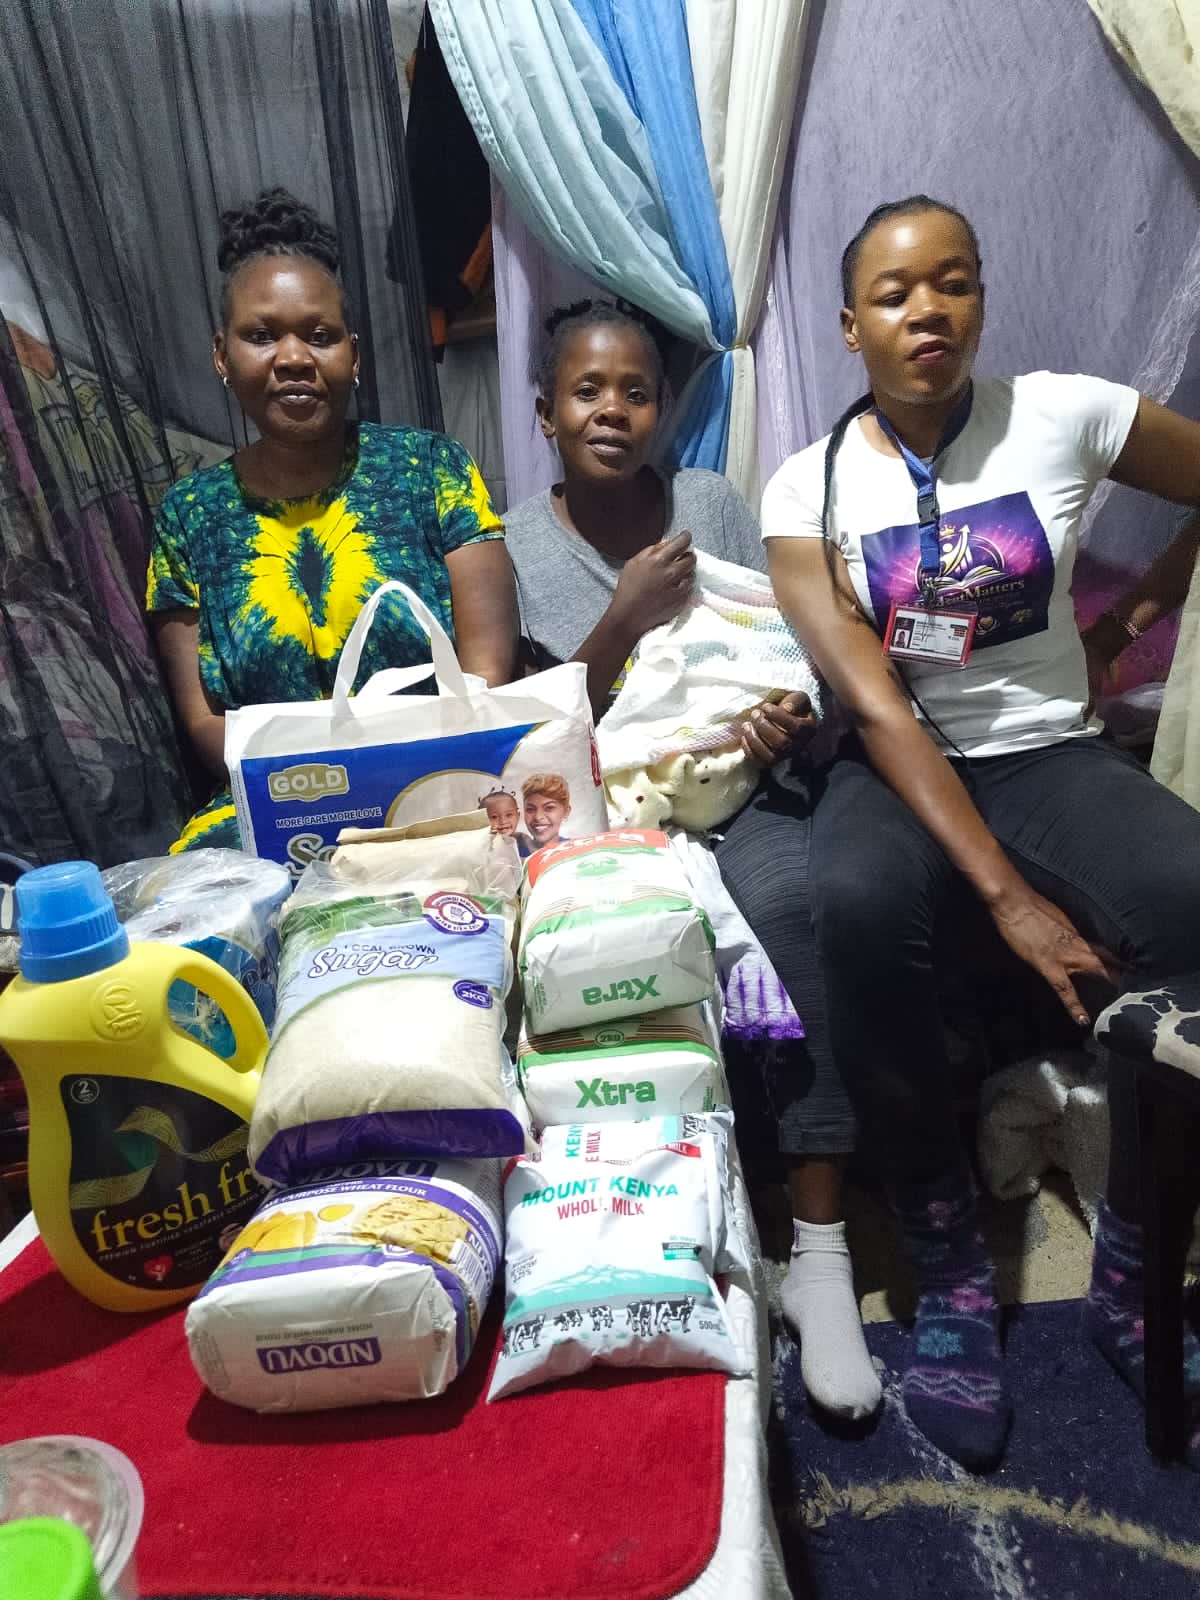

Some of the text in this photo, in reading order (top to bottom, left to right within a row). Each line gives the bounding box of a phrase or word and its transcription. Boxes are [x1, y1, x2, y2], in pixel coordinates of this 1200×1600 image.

[273, 769, 342, 793] GOLD
[275, 806, 383, 829] MORE CARE MORE LOVE
[307, 947, 439, 979] Sugar
[582, 974, 661, 1006] Xtra
[575, 1078, 657, 1109] Xtra
[565, 1123, 584, 1158] KENY
[340, 1183, 383, 1192] WHEAT
[384, 1183, 428, 1197] FLOUR
[521, 1175, 679, 1209] MOUNT KENYA
[91, 1181, 216, 1252] fresh
[611, 1196, 645, 1216] MILK
[265, 1340, 375, 1371] NDOVU
